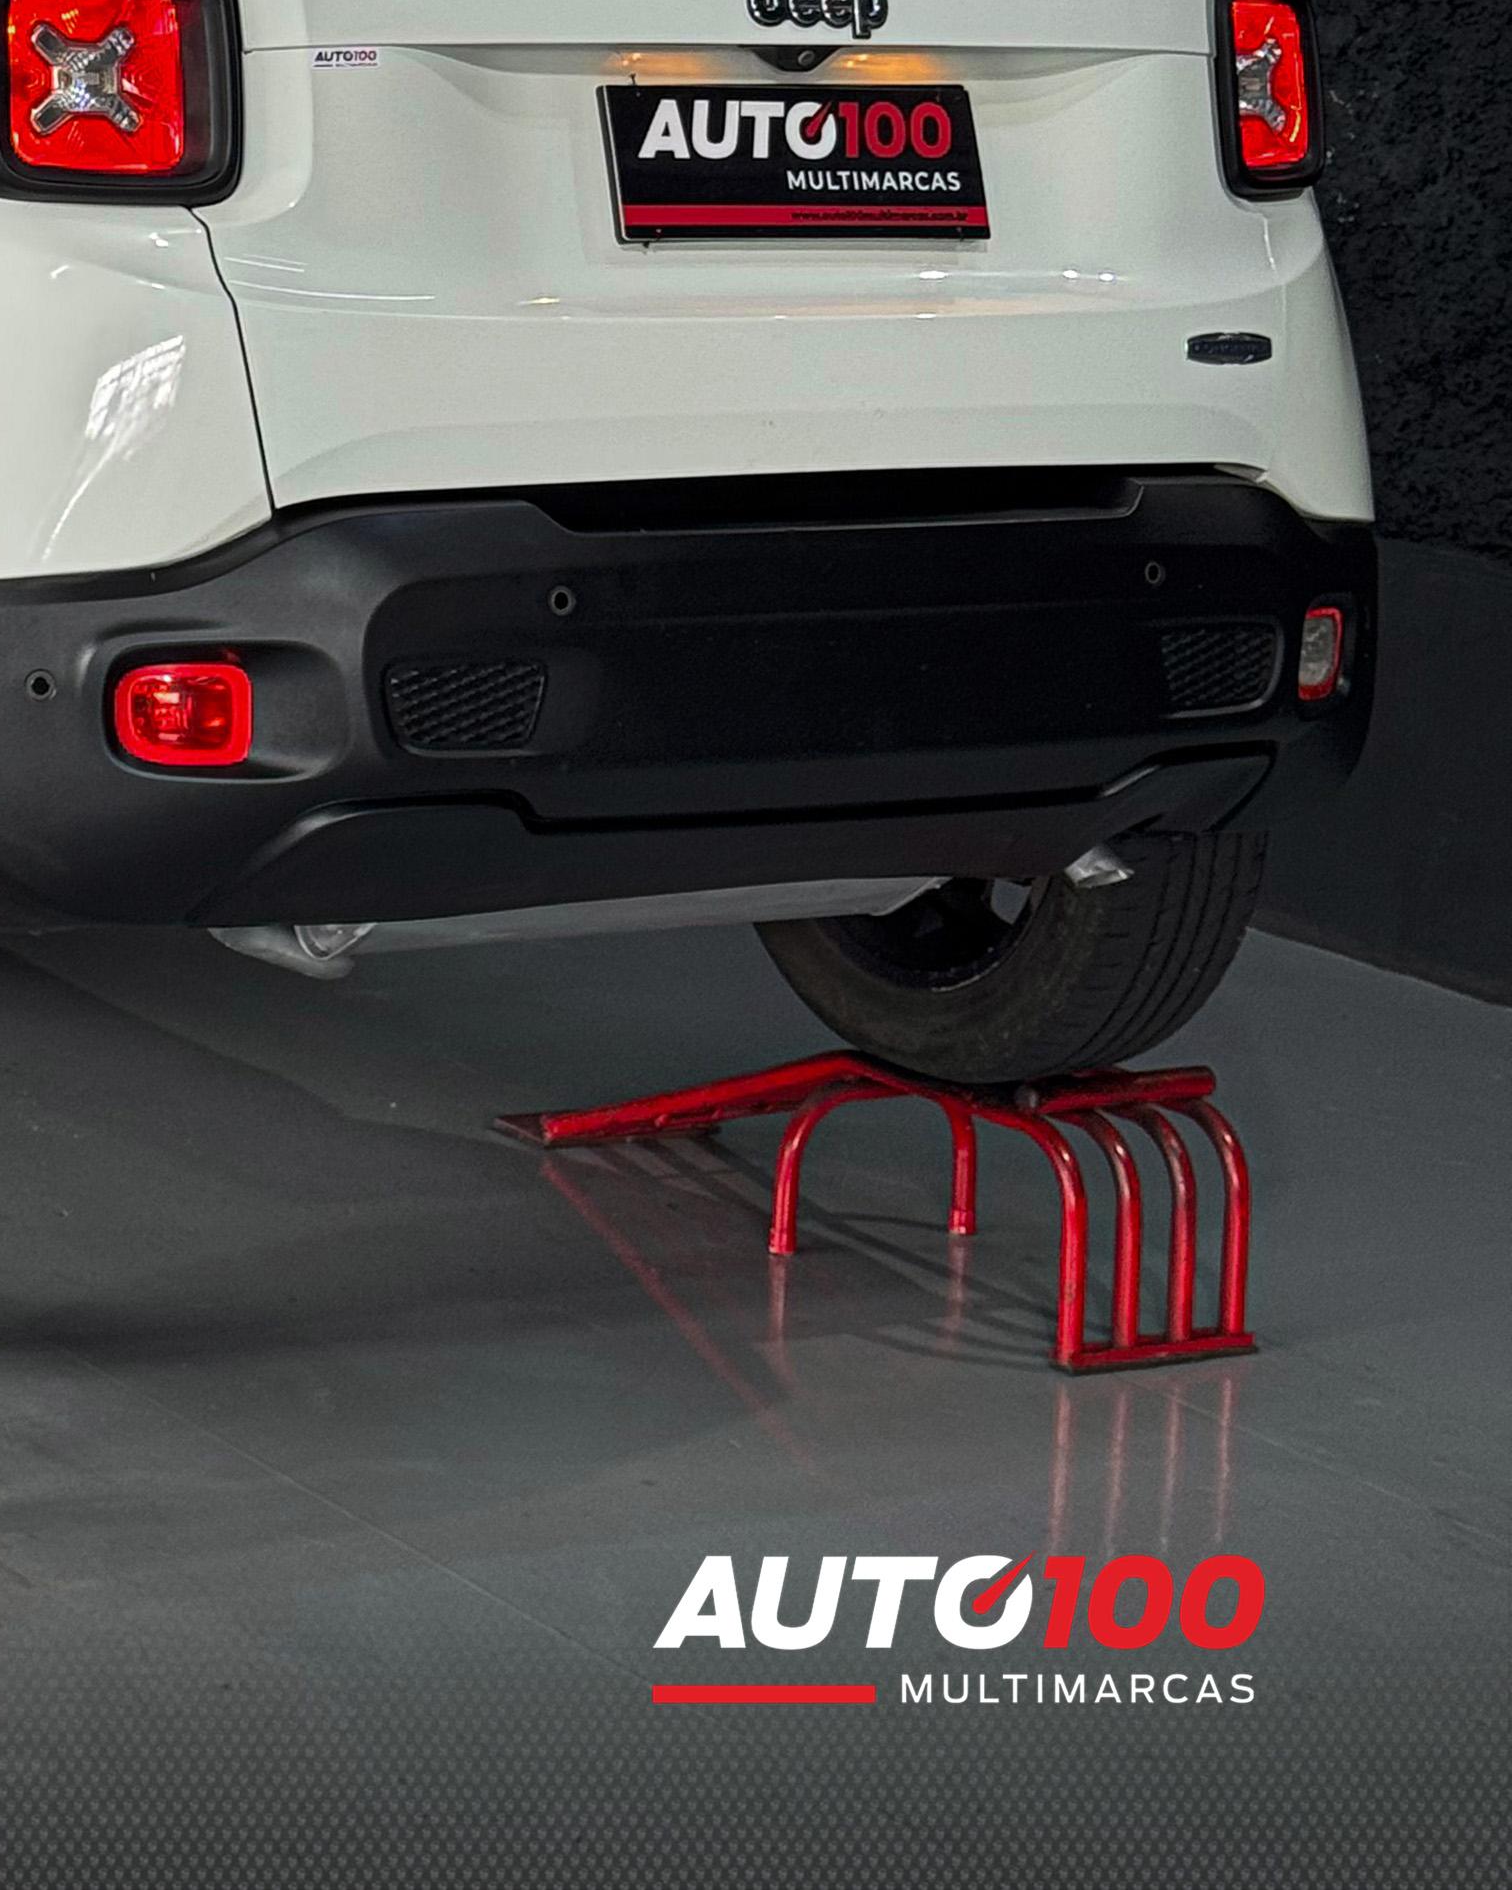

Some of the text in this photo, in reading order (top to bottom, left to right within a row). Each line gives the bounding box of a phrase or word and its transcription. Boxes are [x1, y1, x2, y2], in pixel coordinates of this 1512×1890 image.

[314, 50, 378, 62] AUTO100
[638, 98, 953, 160] AUTO100
[786, 170, 962, 192] MULTIMARCAS
